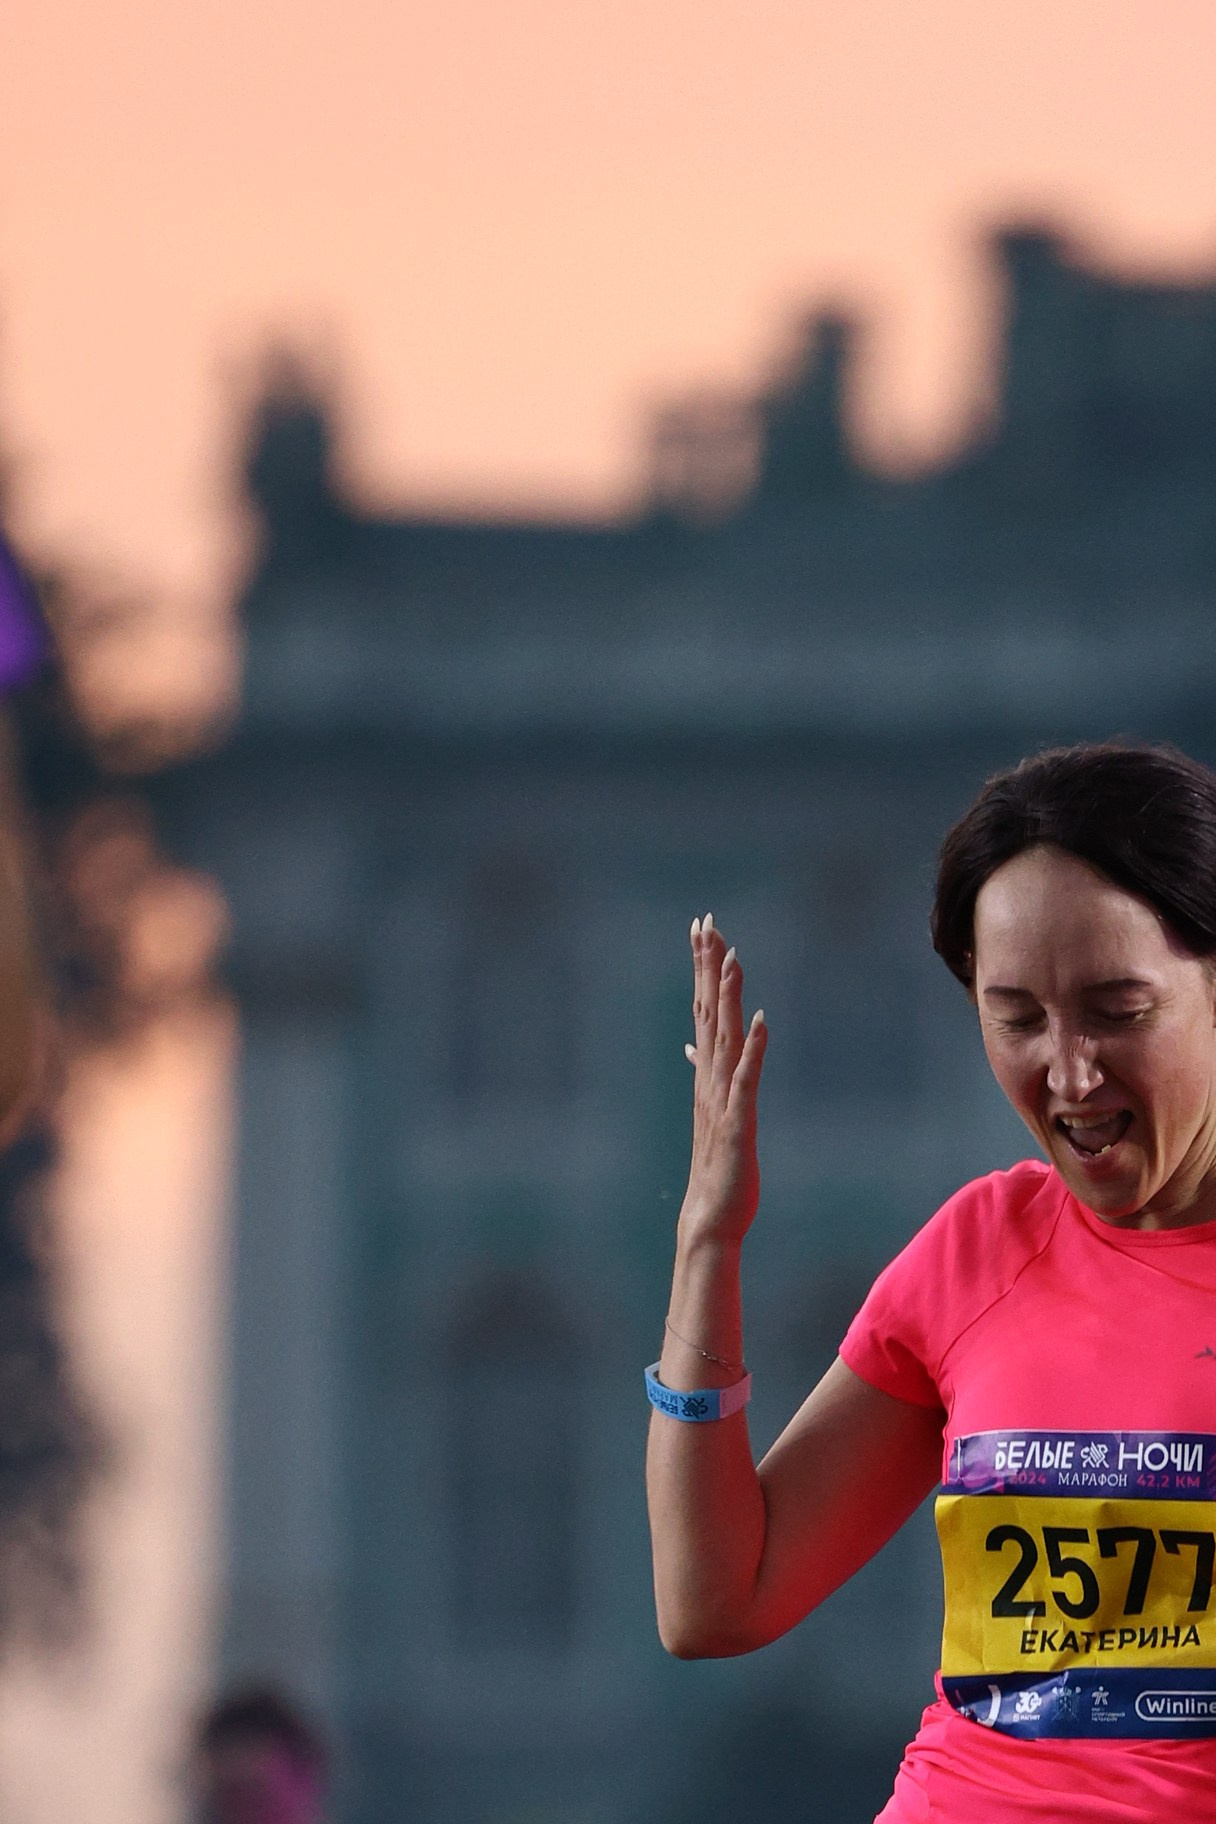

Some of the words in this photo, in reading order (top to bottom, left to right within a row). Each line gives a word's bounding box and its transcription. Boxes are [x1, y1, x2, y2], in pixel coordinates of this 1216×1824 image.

[994, 1440, 1076, 1471] БЕЛЫЕ
[1117, 1441, 1204, 1473] НОЧИ
[1009, 1471, 1047, 1486] 2024
[1057, 1471, 1128, 1487] МАРАФОН
[1174, 1475, 1201, 1488] КМ
[984, 1523, 1216, 1621] 2577
[1019, 1624, 1202, 1655] ЕКАТЕРИНА
